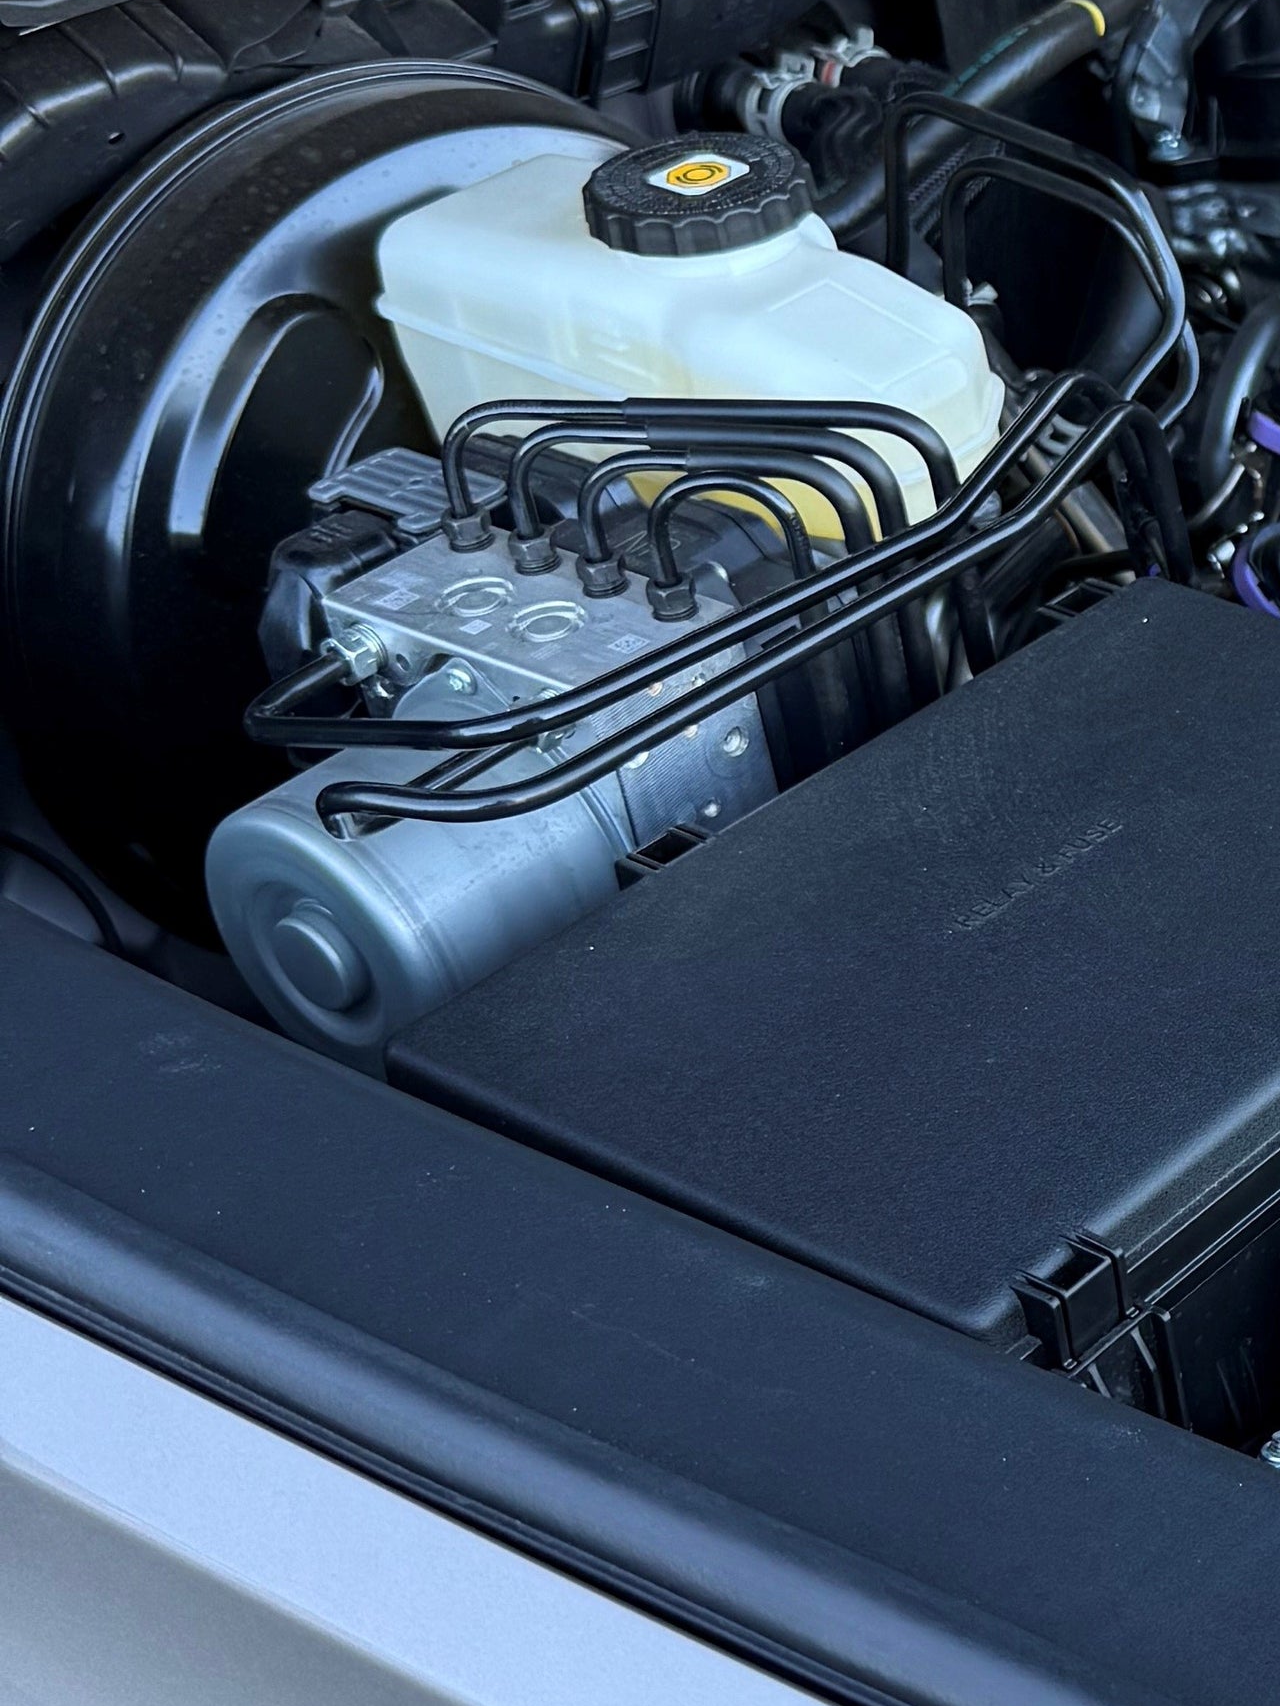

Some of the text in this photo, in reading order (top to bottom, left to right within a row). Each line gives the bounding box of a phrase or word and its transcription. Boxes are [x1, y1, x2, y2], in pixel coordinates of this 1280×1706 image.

[953, 818, 1124, 930] RELAY & FUSE
